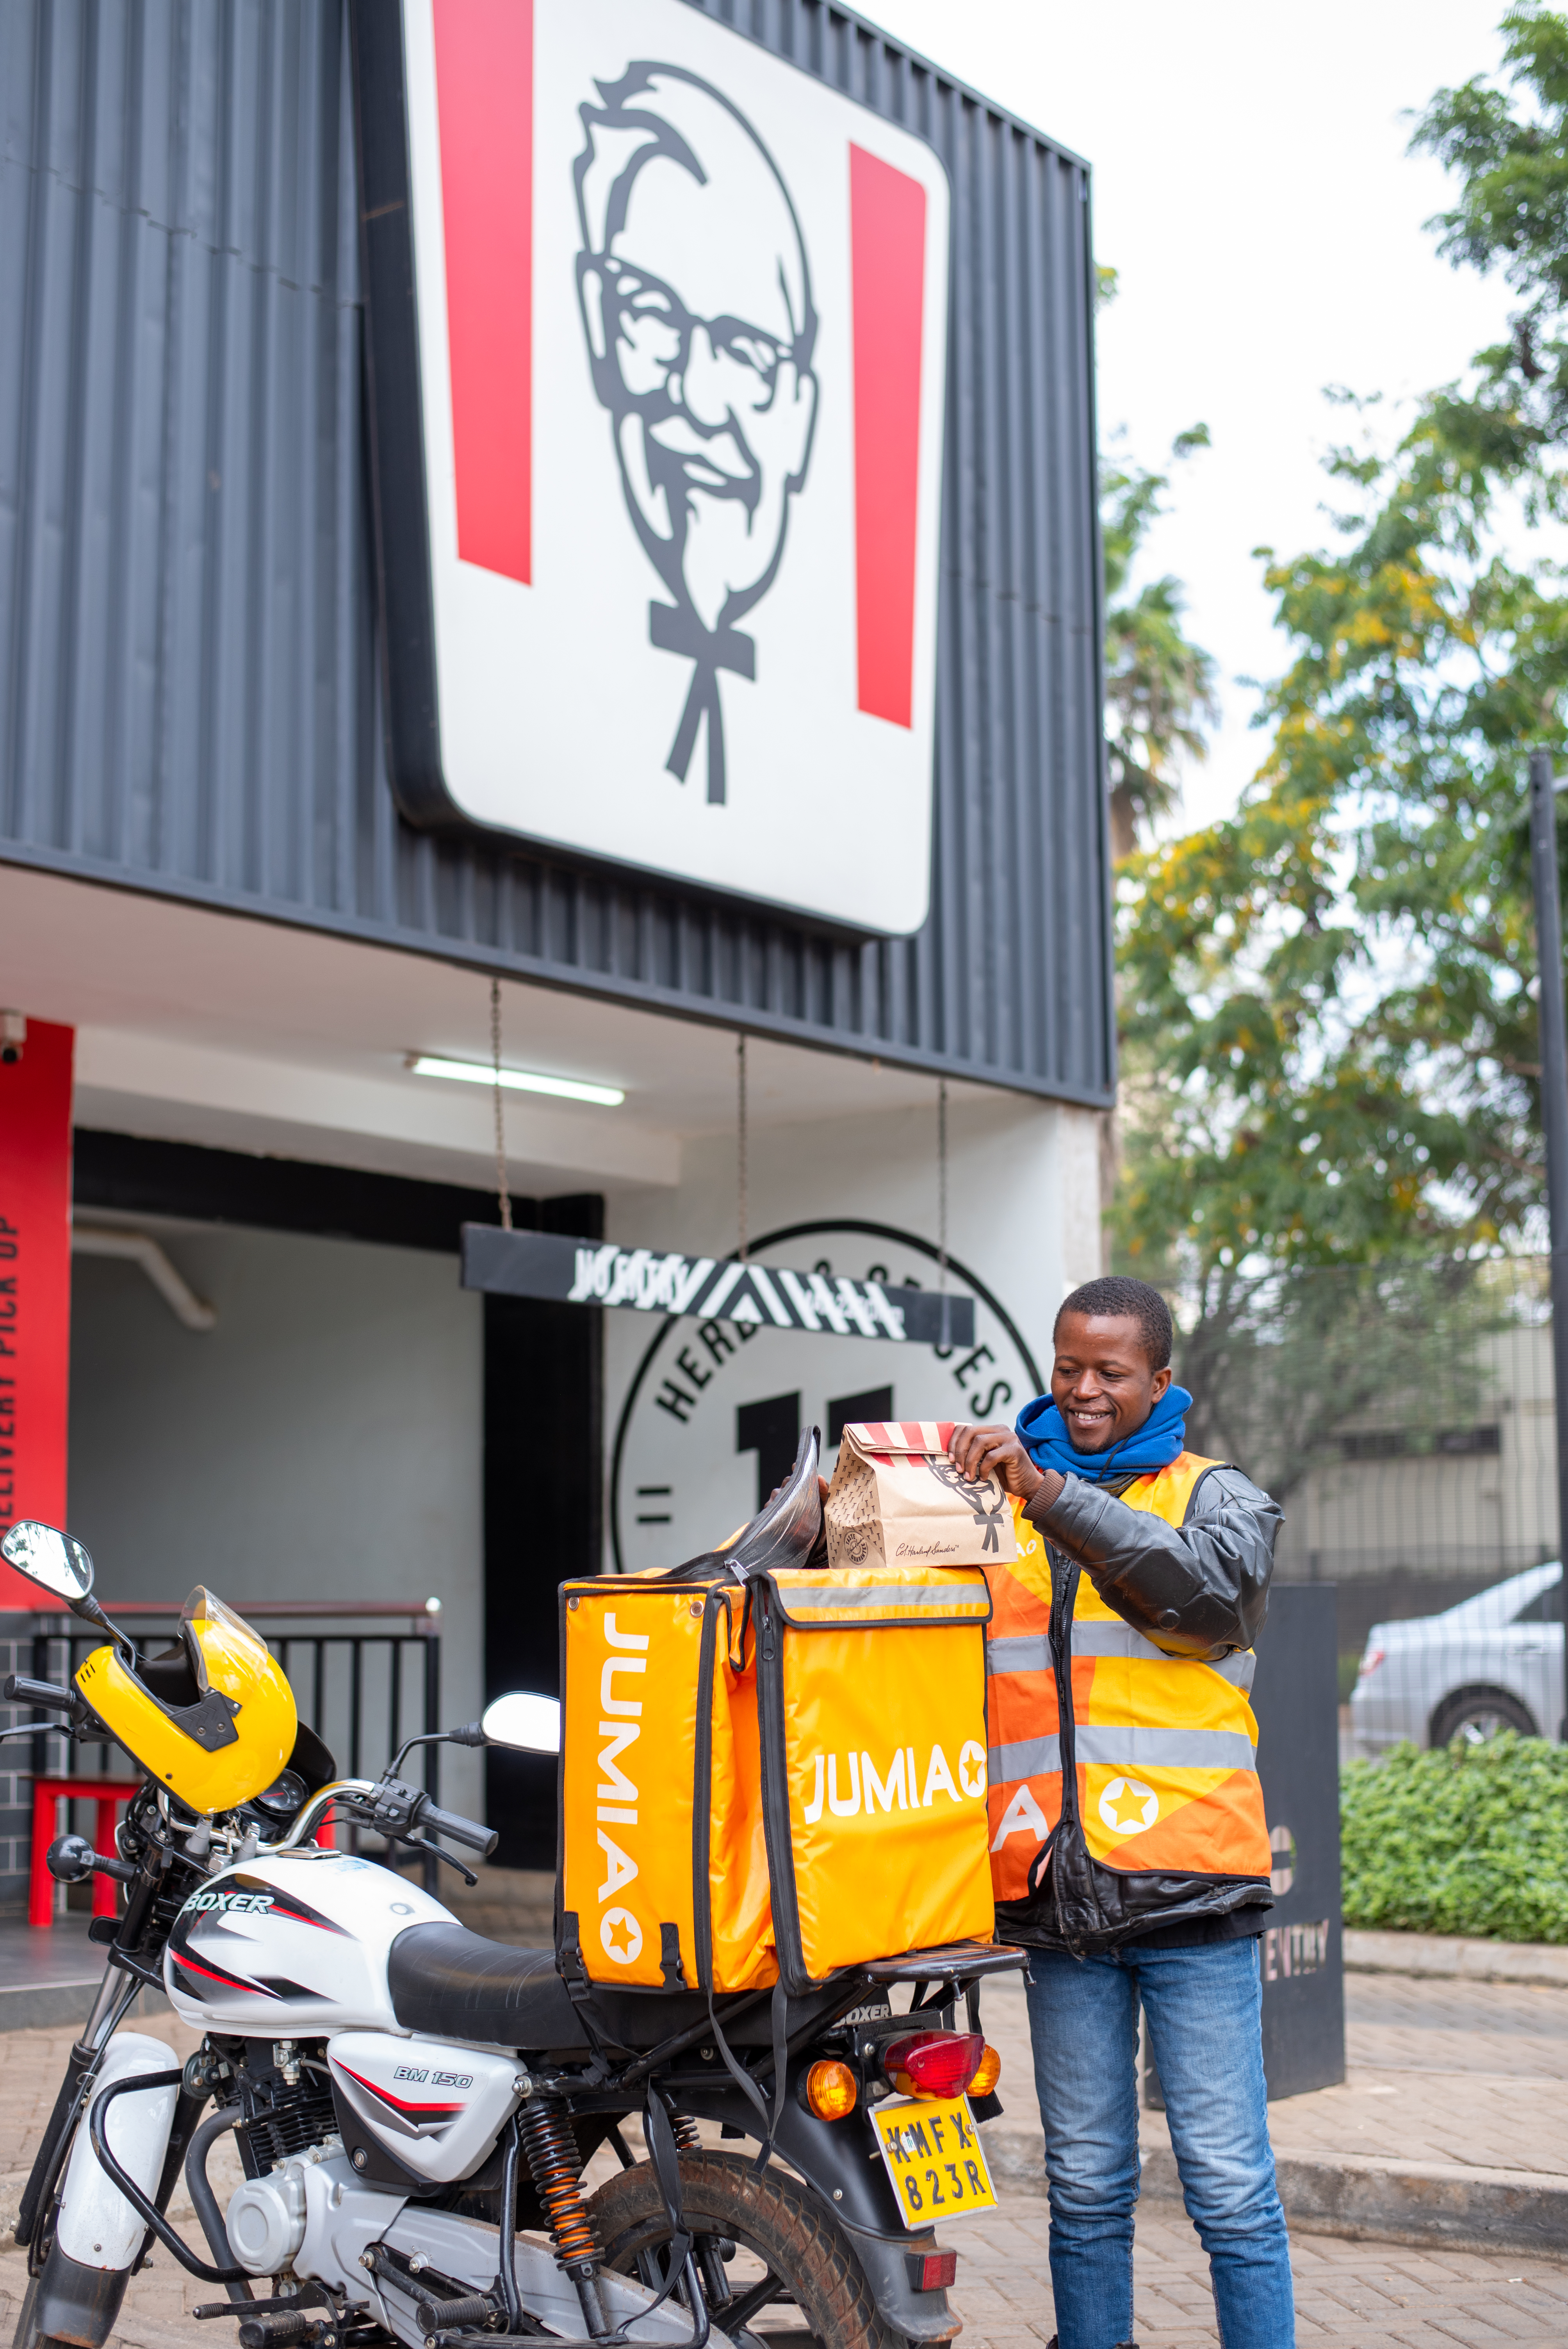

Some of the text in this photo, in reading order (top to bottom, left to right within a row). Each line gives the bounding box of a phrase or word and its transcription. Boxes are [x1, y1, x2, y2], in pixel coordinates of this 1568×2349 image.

[846, 1534, 856, 1545] TASTE
[851, 1542, 867, 1562] GUARANTEE
[597, 1613, 650, 1904] JUMIA
[804, 1744, 962, 1825] JUMIA
[183, 1893, 275, 1914] BOXER
[394, 2066, 473, 2089] BM 150
[886, 2111, 972, 2164] KMFX
[904, 2159, 987, 2211] 823R
